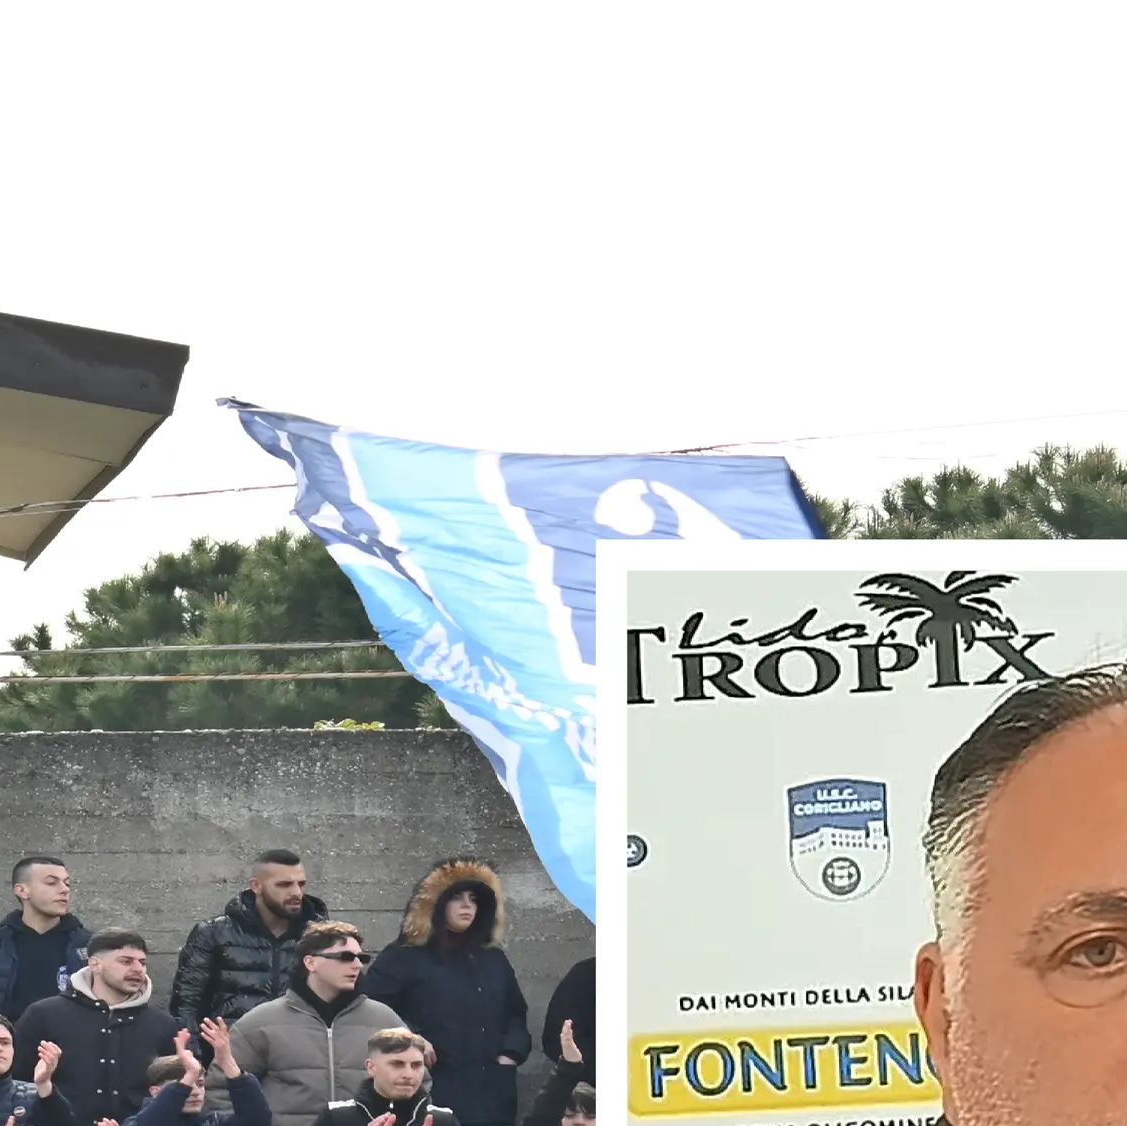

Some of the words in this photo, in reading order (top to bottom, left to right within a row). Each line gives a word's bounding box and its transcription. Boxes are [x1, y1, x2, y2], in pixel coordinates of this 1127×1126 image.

[793, 800, 883, 816] CORIGLIANO
[680, 995, 716, 1011] DAI
[725, 991, 795, 1010] MONTI
[805, 987, 870, 1006] DELLA
[643, 1032, 938, 1098] FONTEN
